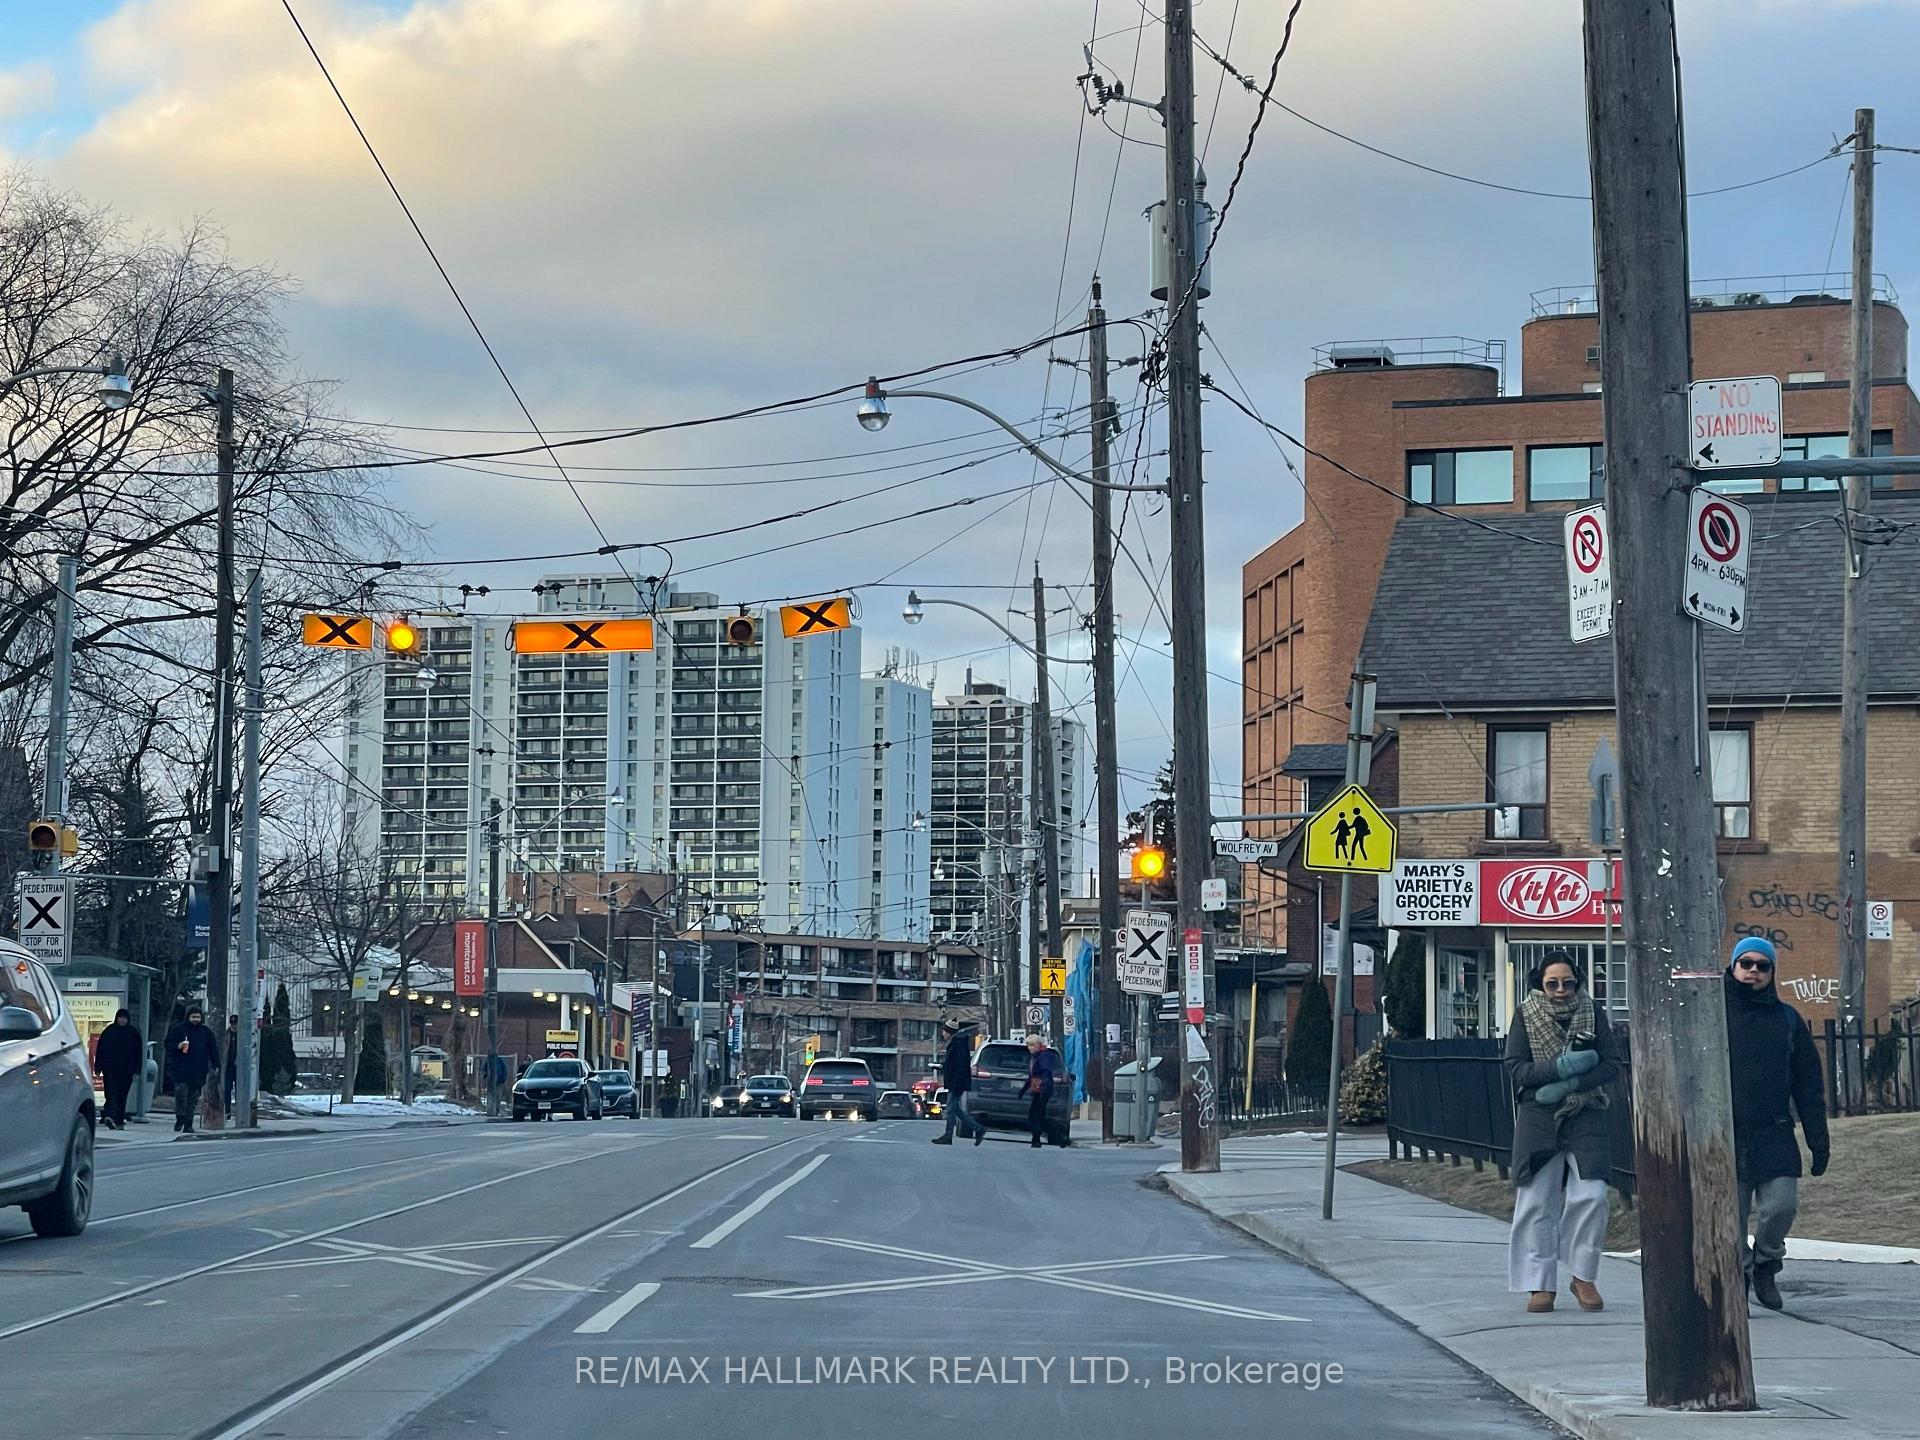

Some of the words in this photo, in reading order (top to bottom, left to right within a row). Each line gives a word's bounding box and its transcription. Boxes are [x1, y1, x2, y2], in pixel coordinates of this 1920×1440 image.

[1719, 383, 1751, 409] NO
[1694, 410, 1777, 439] STANDING
[1690, 554, 1709, 574] 4PM
[1576, 604, 1597, 621] EXCEPT
[1599, 603, 1607, 615] BY
[1582, 616, 1602, 632] PERMIT
[1220, 842, 1261, 854] WOLFREY
[1262, 844, 1274, 854] AV
[1403, 863, 1465, 877] MARY'S
[23, 884, 65, 894] PEDESTRIAN
[1395, 879, 1462, 893] VARIETY
[1464, 882, 1474, 893] &
[1395, 894, 1472, 909] GROCERY
[1130, 916, 1168, 928] PEDESTRIAN
[1406, 910, 1462, 921] STORE
[26, 936, 42, 946] STOP
[46, 936, 59, 946] FOR
[1129, 965, 1145, 975] STOP
[1148, 967, 1160, 976] FOR
[1125, 975, 1163, 988] PEDESTRIANS
[1781, 974, 1840, 1000] TWICE
